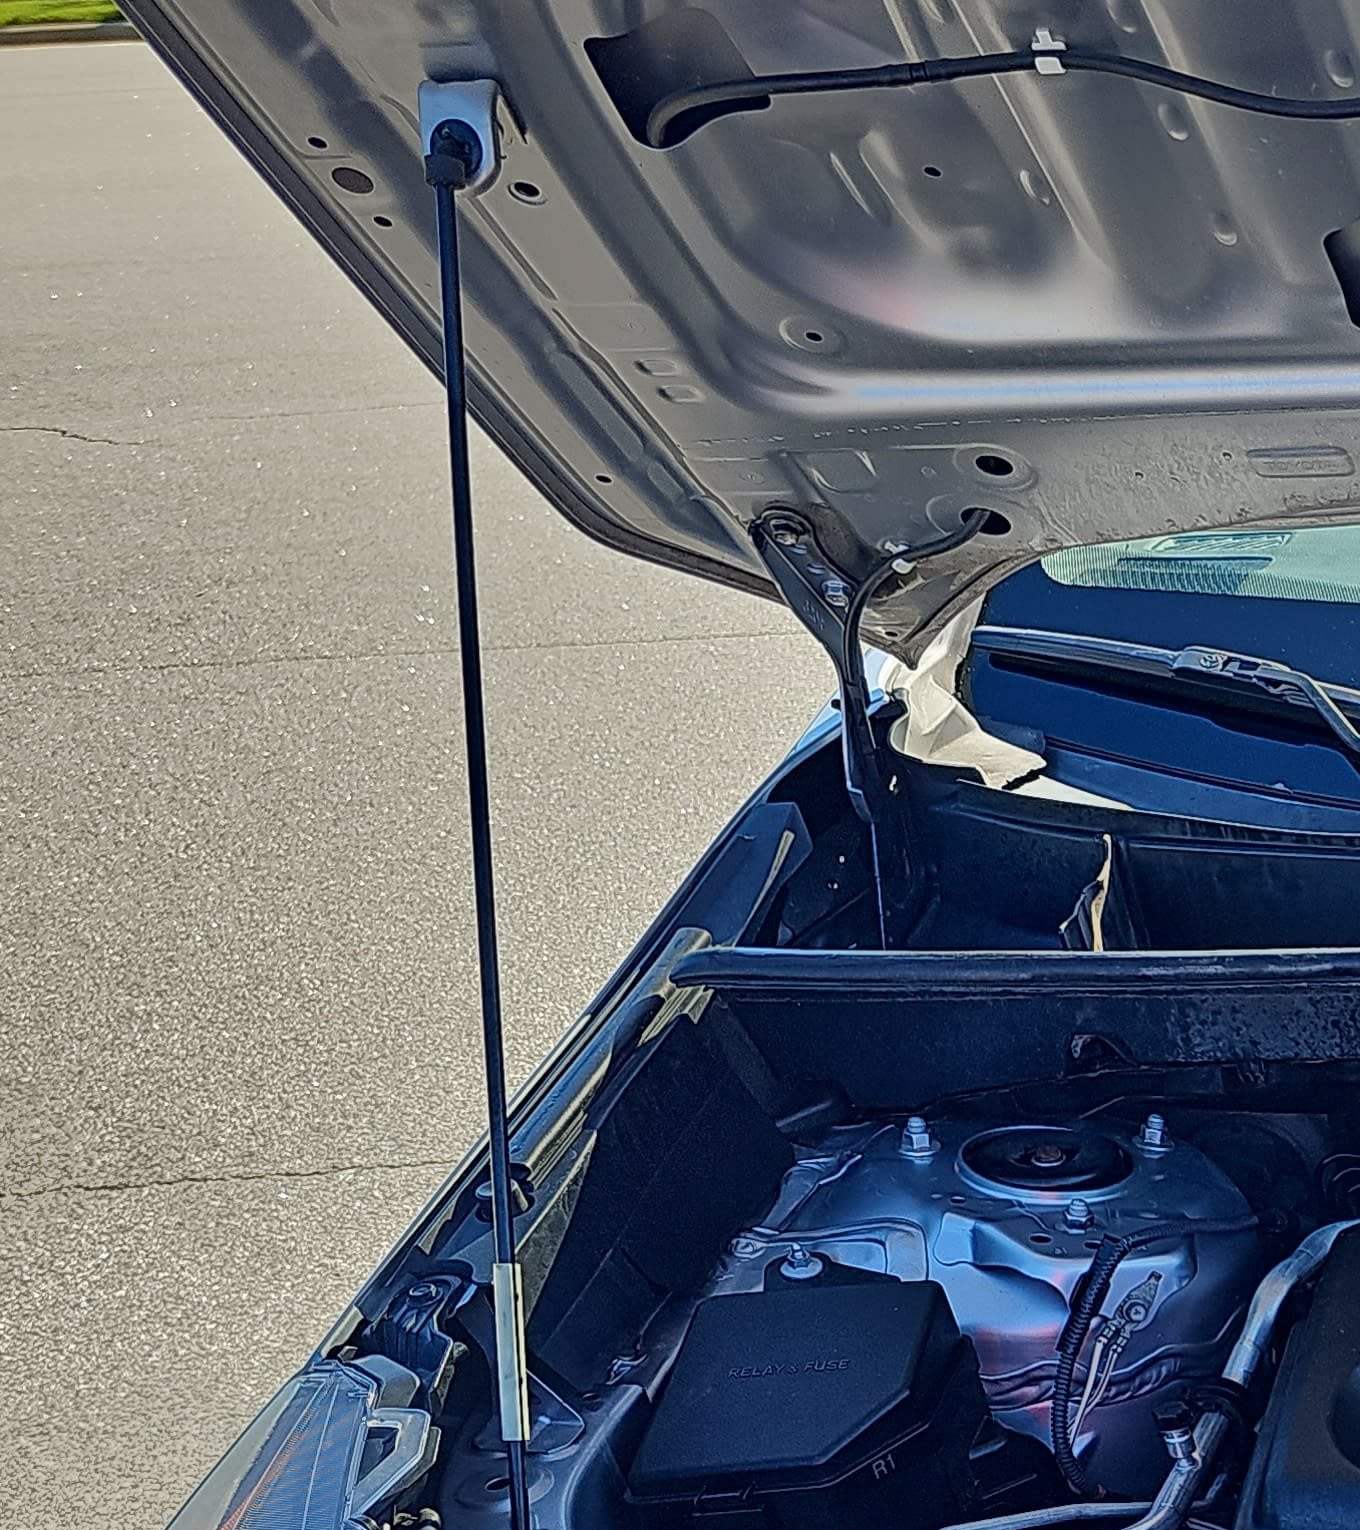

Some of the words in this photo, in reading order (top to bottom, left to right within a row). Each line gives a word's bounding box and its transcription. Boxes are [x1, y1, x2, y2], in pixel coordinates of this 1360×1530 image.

[728, 1364, 784, 1379] RELAY
[804, 1358, 850, 1373] FUSE
[872, 1453, 896, 1479] R1
